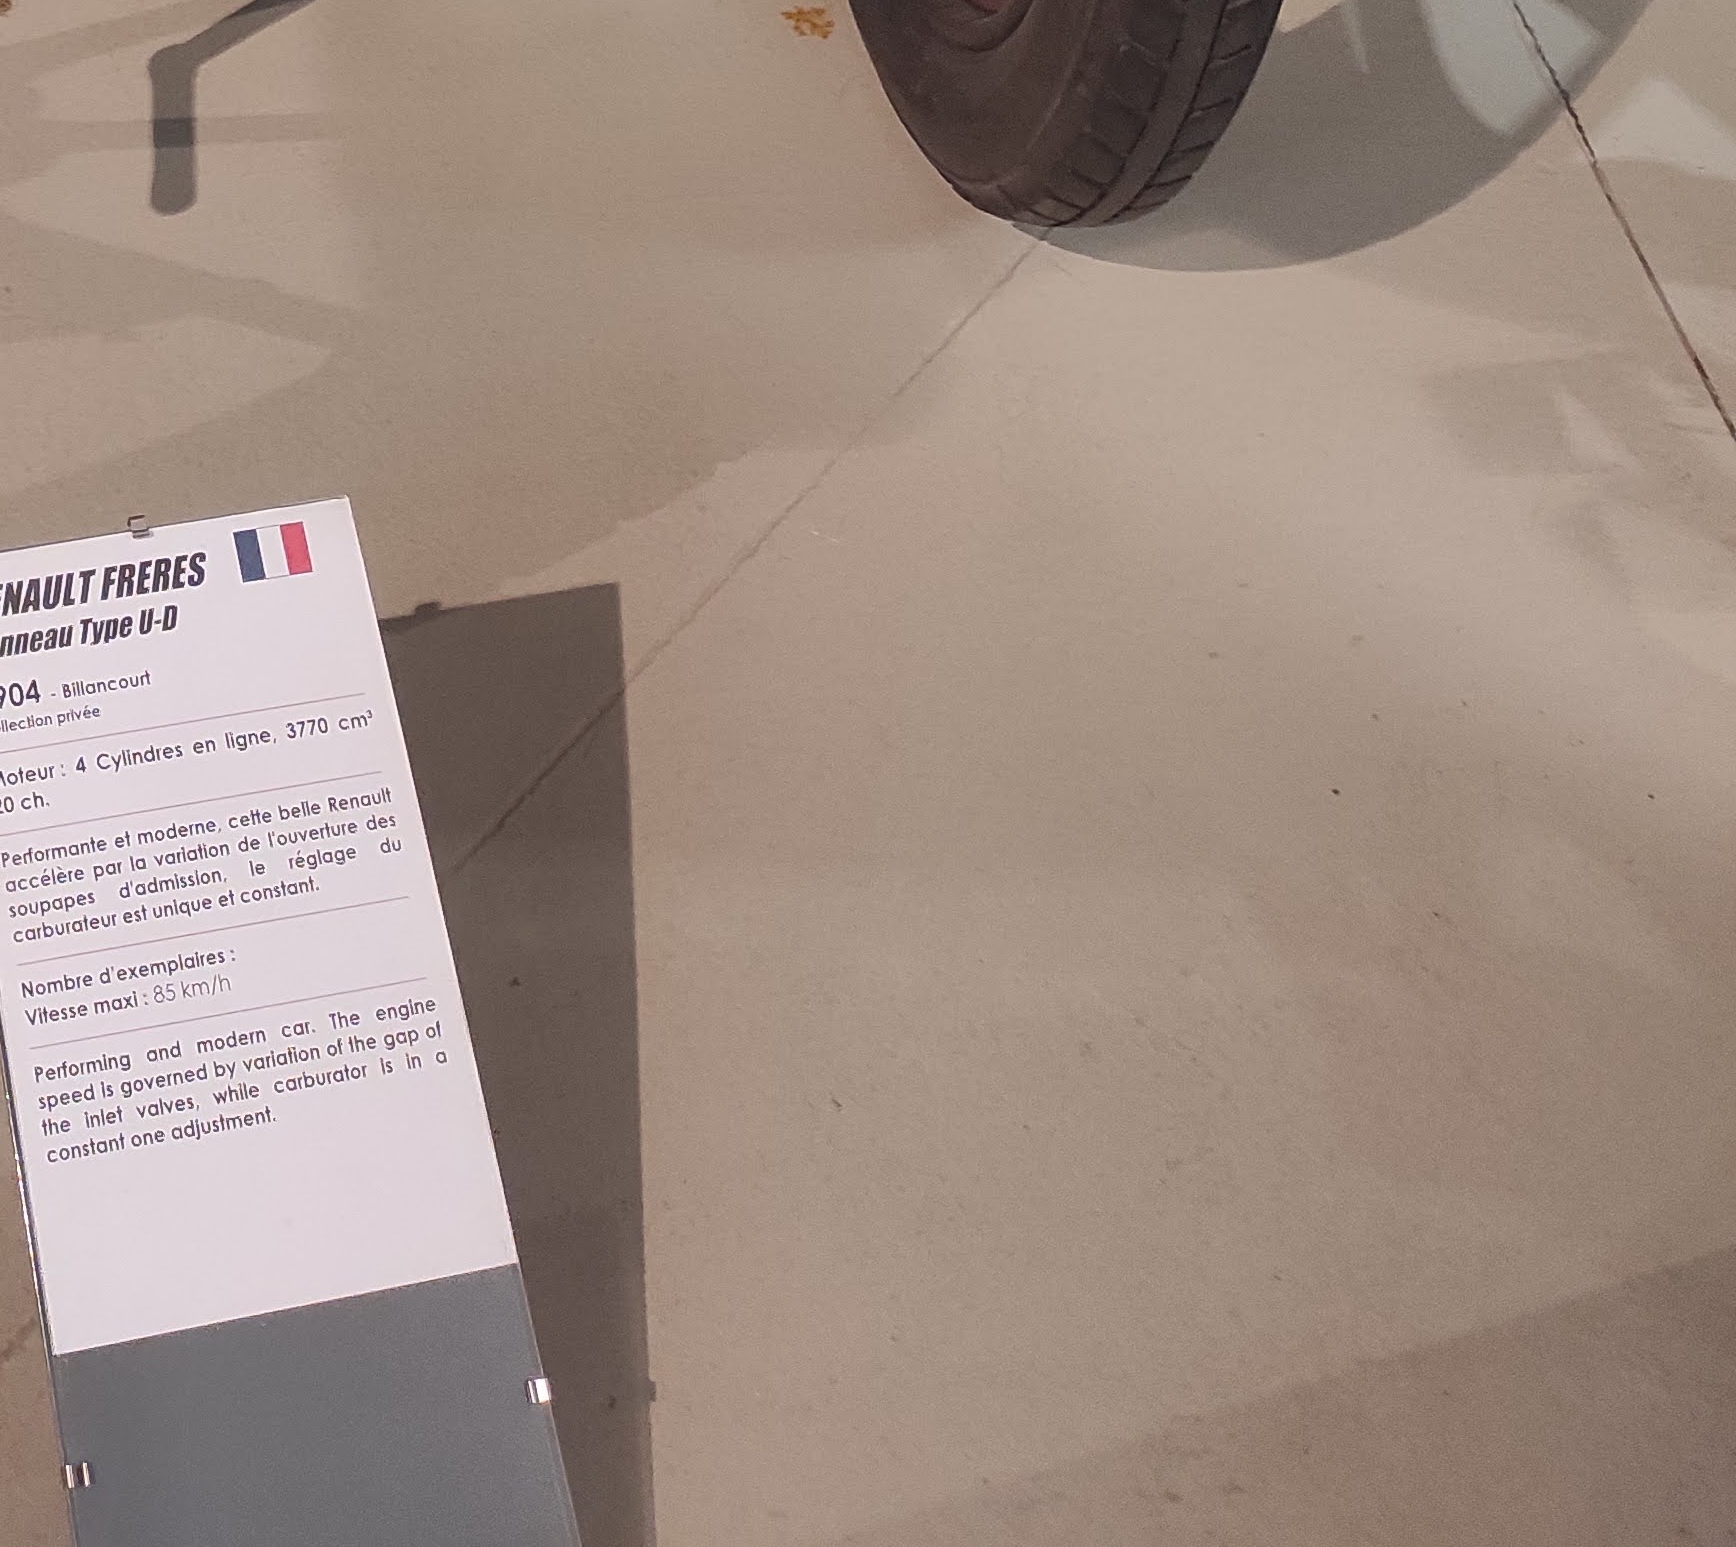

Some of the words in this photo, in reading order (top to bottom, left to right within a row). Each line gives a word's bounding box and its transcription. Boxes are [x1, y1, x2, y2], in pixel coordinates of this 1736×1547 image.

[100, 552, 207, 600] FRERES
[79, 615, 134, 647] Type
[138, 604, 179, 636] U-D
[60, 669, 152, 700] Billancourt
[56, 704, 102, 728] privée
[75, 755, 88, 774] 4
[95, 744, 184, 774] Cylindres
[192, 738, 217, 755] en
[224, 730, 277, 752] ligne,
[284, 716, 329, 740] 3770
[0, 835, 108, 869] Performante
[113, 830, 132, 849] et
[136, 820, 222, 846] moderne,
[227, 808, 273, 830] cette
[277, 799, 322, 821] belle
[326, 786, 392, 813] Renault
[20, 791, 51, 811] ch.
[4, 865, 85, 894] accélère
[92, 860, 123, 883] par
[128, 854, 148, 872] la
[152, 842, 231, 867] variation
[237, 835, 261, 853] de
[266, 821, 359, 849] l'ouverture
[365, 813, 397, 832] des
[8, 891, 96, 919] soupapes
[118, 869, 228, 900] d'admission,
[248, 859, 266, 878] le
[287, 847, 357, 871] réglage
[379, 836, 402, 855] du
[12, 913, 117, 944] carburateur
[122, 903, 148, 925] est
[151, 897, 213, 920] unique
[217, 888, 236, 908] et
[239, 875, 320, 904] constant.
[20, 973, 94, 999] Nombre
[23, 1003, 89, 1027] Vitesse
[152, 982, 177, 1004] 85
[179, 973, 232, 999] km/h
[33, 1053, 132, 1084] Performing
[145, 1039, 183, 1063] and
[195, 1029, 267, 1055] modern
[280, 1020, 317, 1039] car.
[328, 1010, 361, 1031] The
[375, 998, 437, 1022] engine
[37, 1082, 96, 1114] speed
[99, 1080, 115, 1099] is
[119, 1062, 209, 1099] governed
[212, 1060, 237, 1081] by
[241, 1046, 322, 1073] variation
[326, 1037, 344, 1058] of
[347, 1034, 377, 1054] the
[383, 1028, 420, 1051] gap
[425, 1019, 442, 1040] of
[41, 1117, 72, 1138] the
[83, 1104, 124, 1129] inlet
[135, 1096, 200, 1119] valves,
[211, 1081, 260, 1106] while
[273, 1063, 368, 1094] carburator
[378, 1056, 394, 1076] is
[404, 1051, 423, 1070] in
[434, 1050, 448, 1065] a
[46, 1131, 126, 1164] constant
[130, 1129, 166, 1148] one
[170, 1104, 277, 1141] adjustment.
